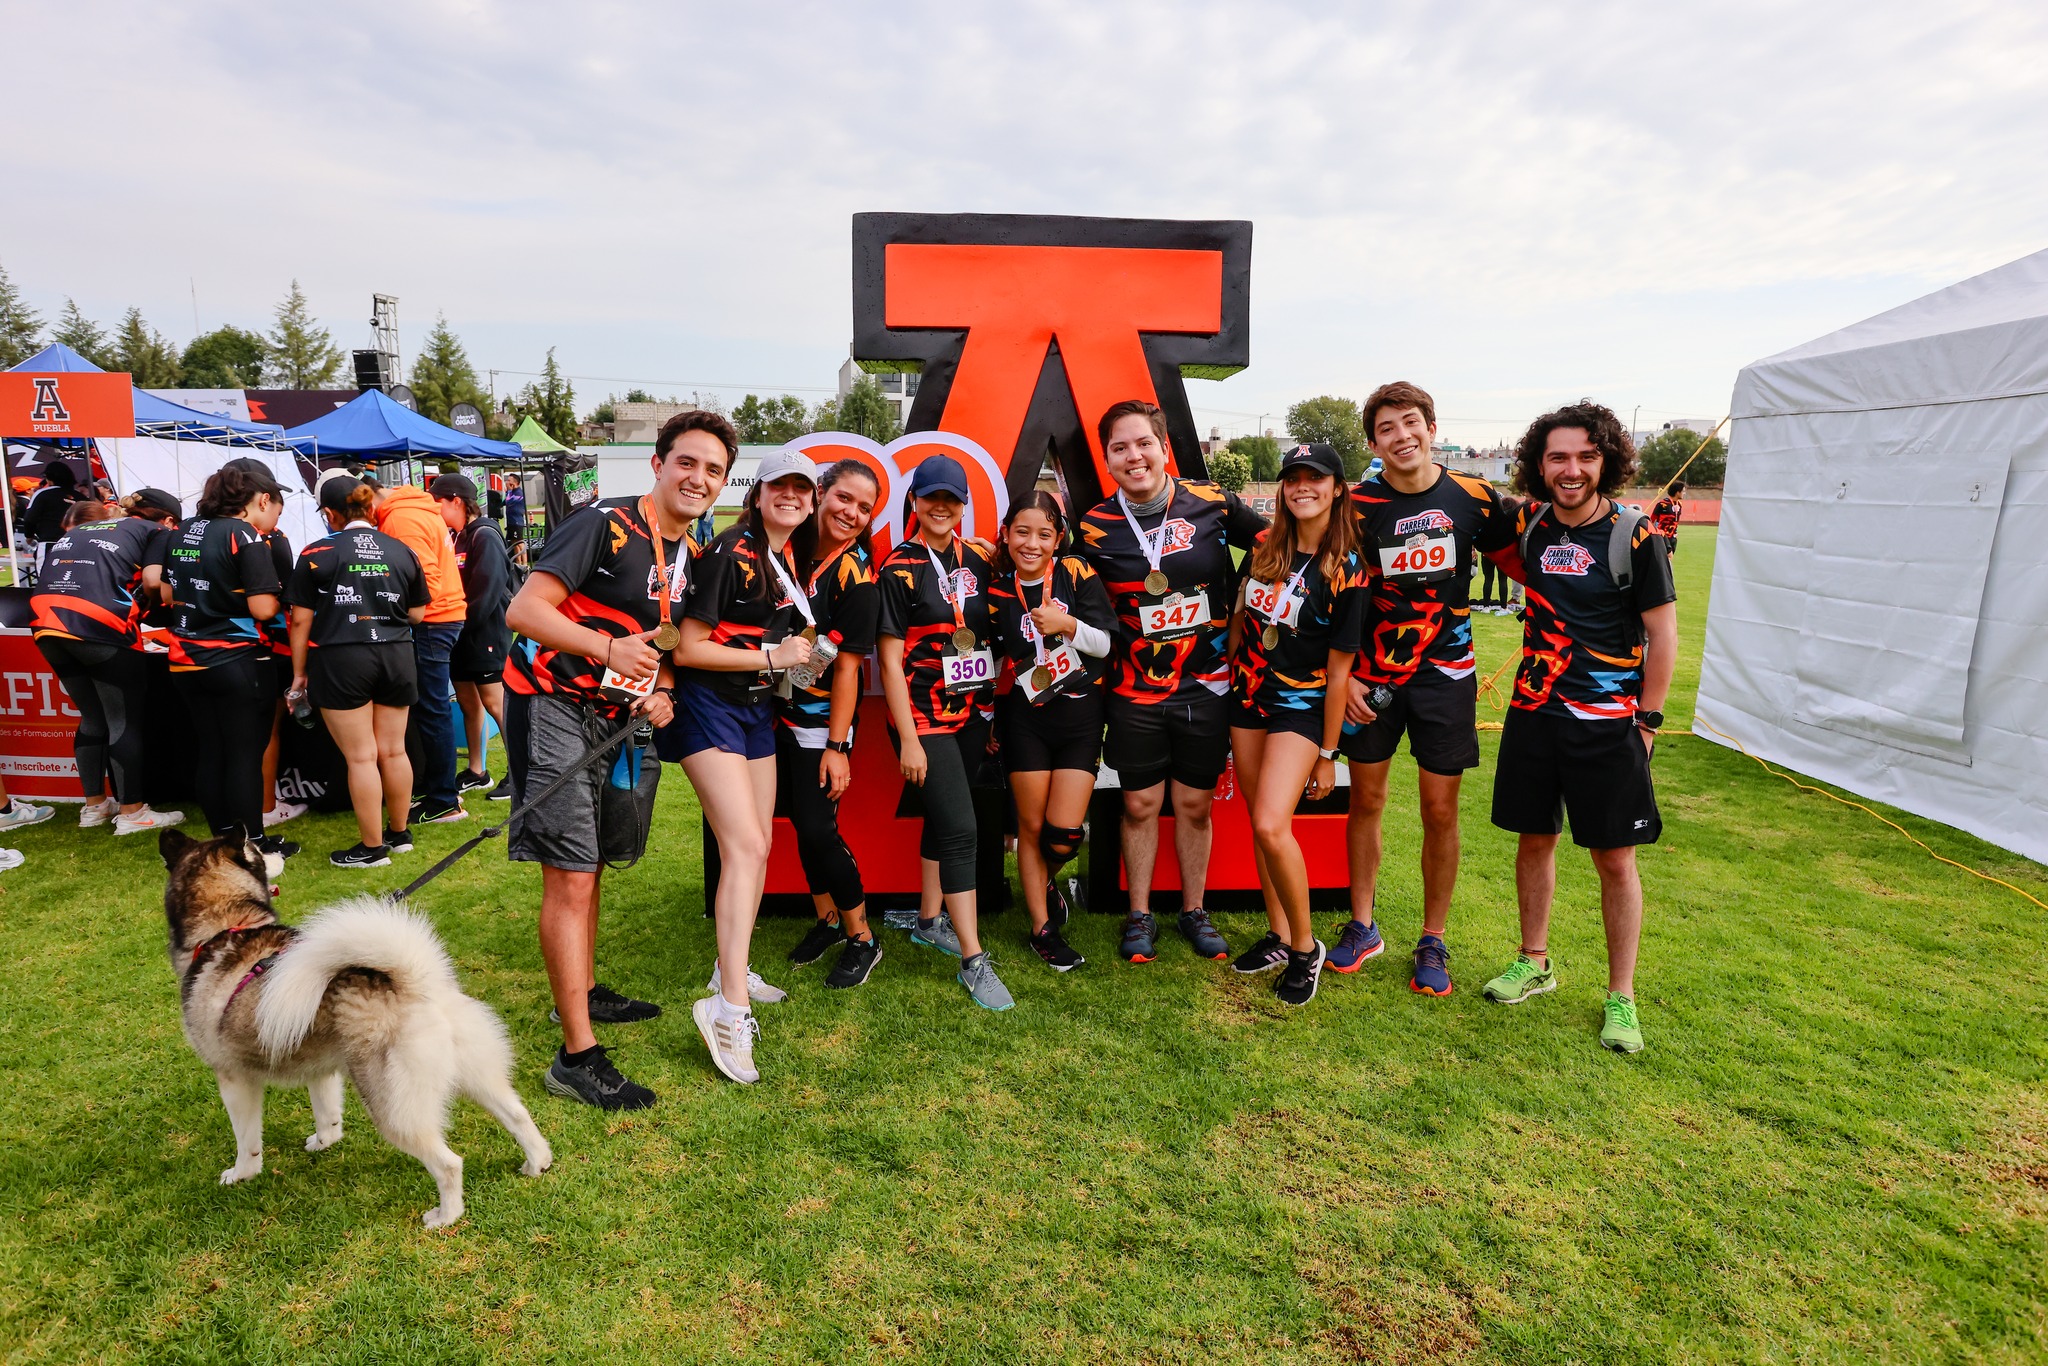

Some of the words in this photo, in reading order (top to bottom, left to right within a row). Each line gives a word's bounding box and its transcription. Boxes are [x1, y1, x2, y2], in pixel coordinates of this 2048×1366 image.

[30, 378, 71, 421] A
[33, 424, 71, 432] PUEBLA
[1400, 517, 1430, 533] CARRERA
[172, 549, 201, 558] ULTRA
[1547, 550, 1575, 558] CARRERA
[1391, 546, 1446, 572] 409
[1547, 557, 1572, 565] LEONES
[348, 563, 390, 572] ULTRA
[334, 593, 362, 602] mac
[1151, 602, 1200, 630] 347
[951, 658, 987, 681] 350
[23, 730, 63, 738] Formación
[14, 762, 61, 771] Inscríbete
